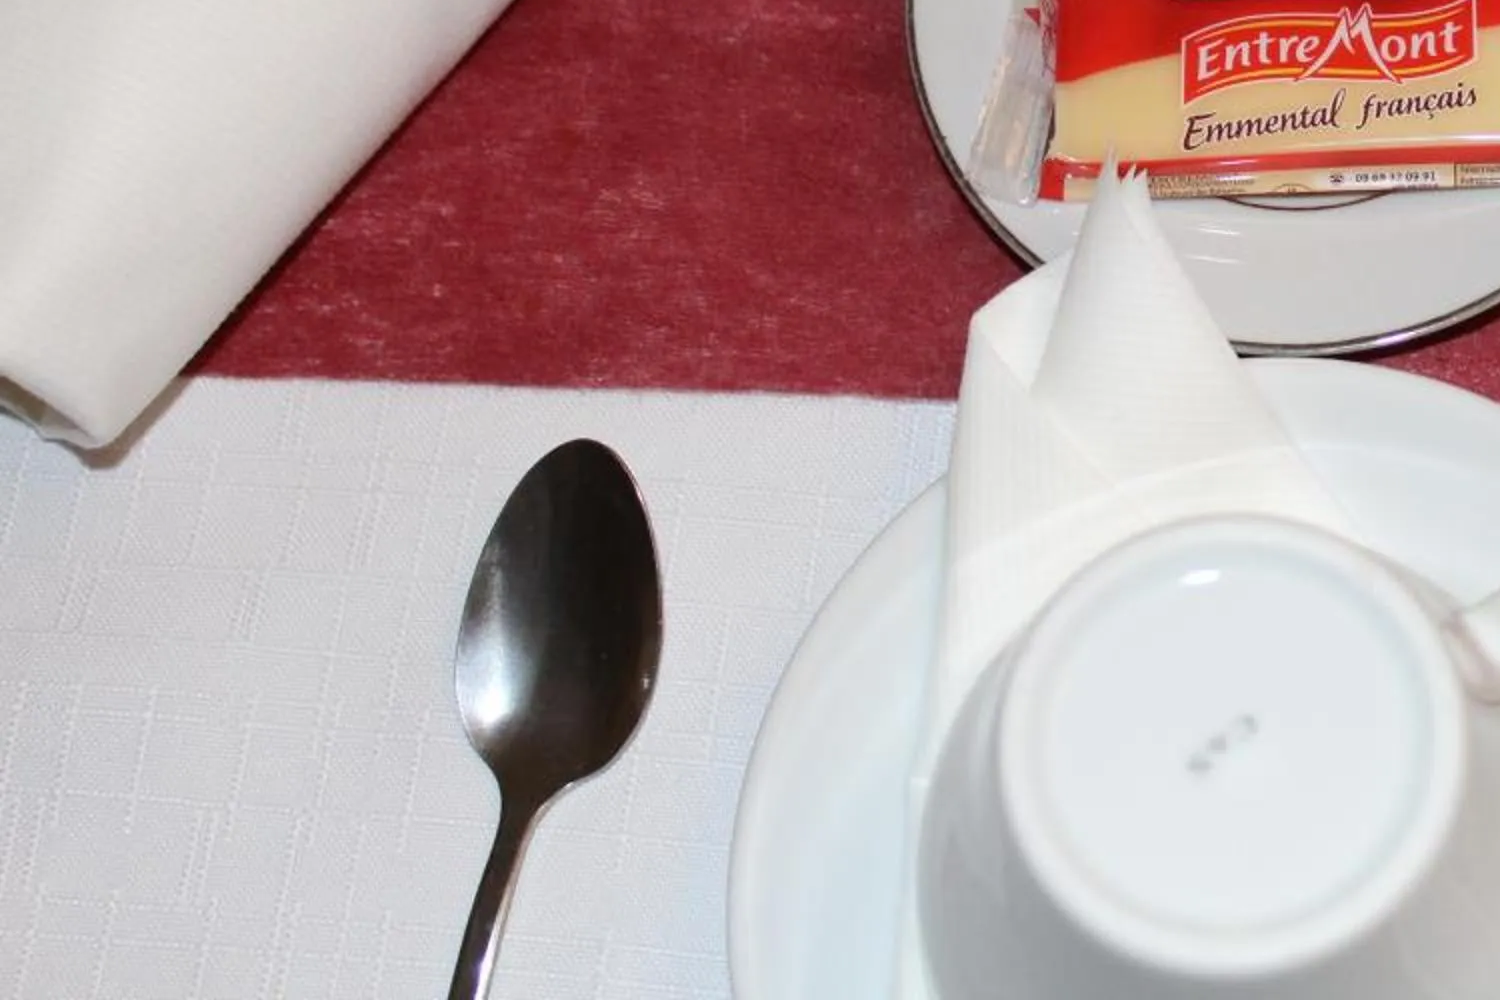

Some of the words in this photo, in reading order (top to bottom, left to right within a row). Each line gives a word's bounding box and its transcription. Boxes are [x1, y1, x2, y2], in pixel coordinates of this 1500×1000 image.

[1196, 3, 1464, 83] EntreMont
[1182, 87, 1347, 151] Emmental
[1355, 81, 1478, 130] français
